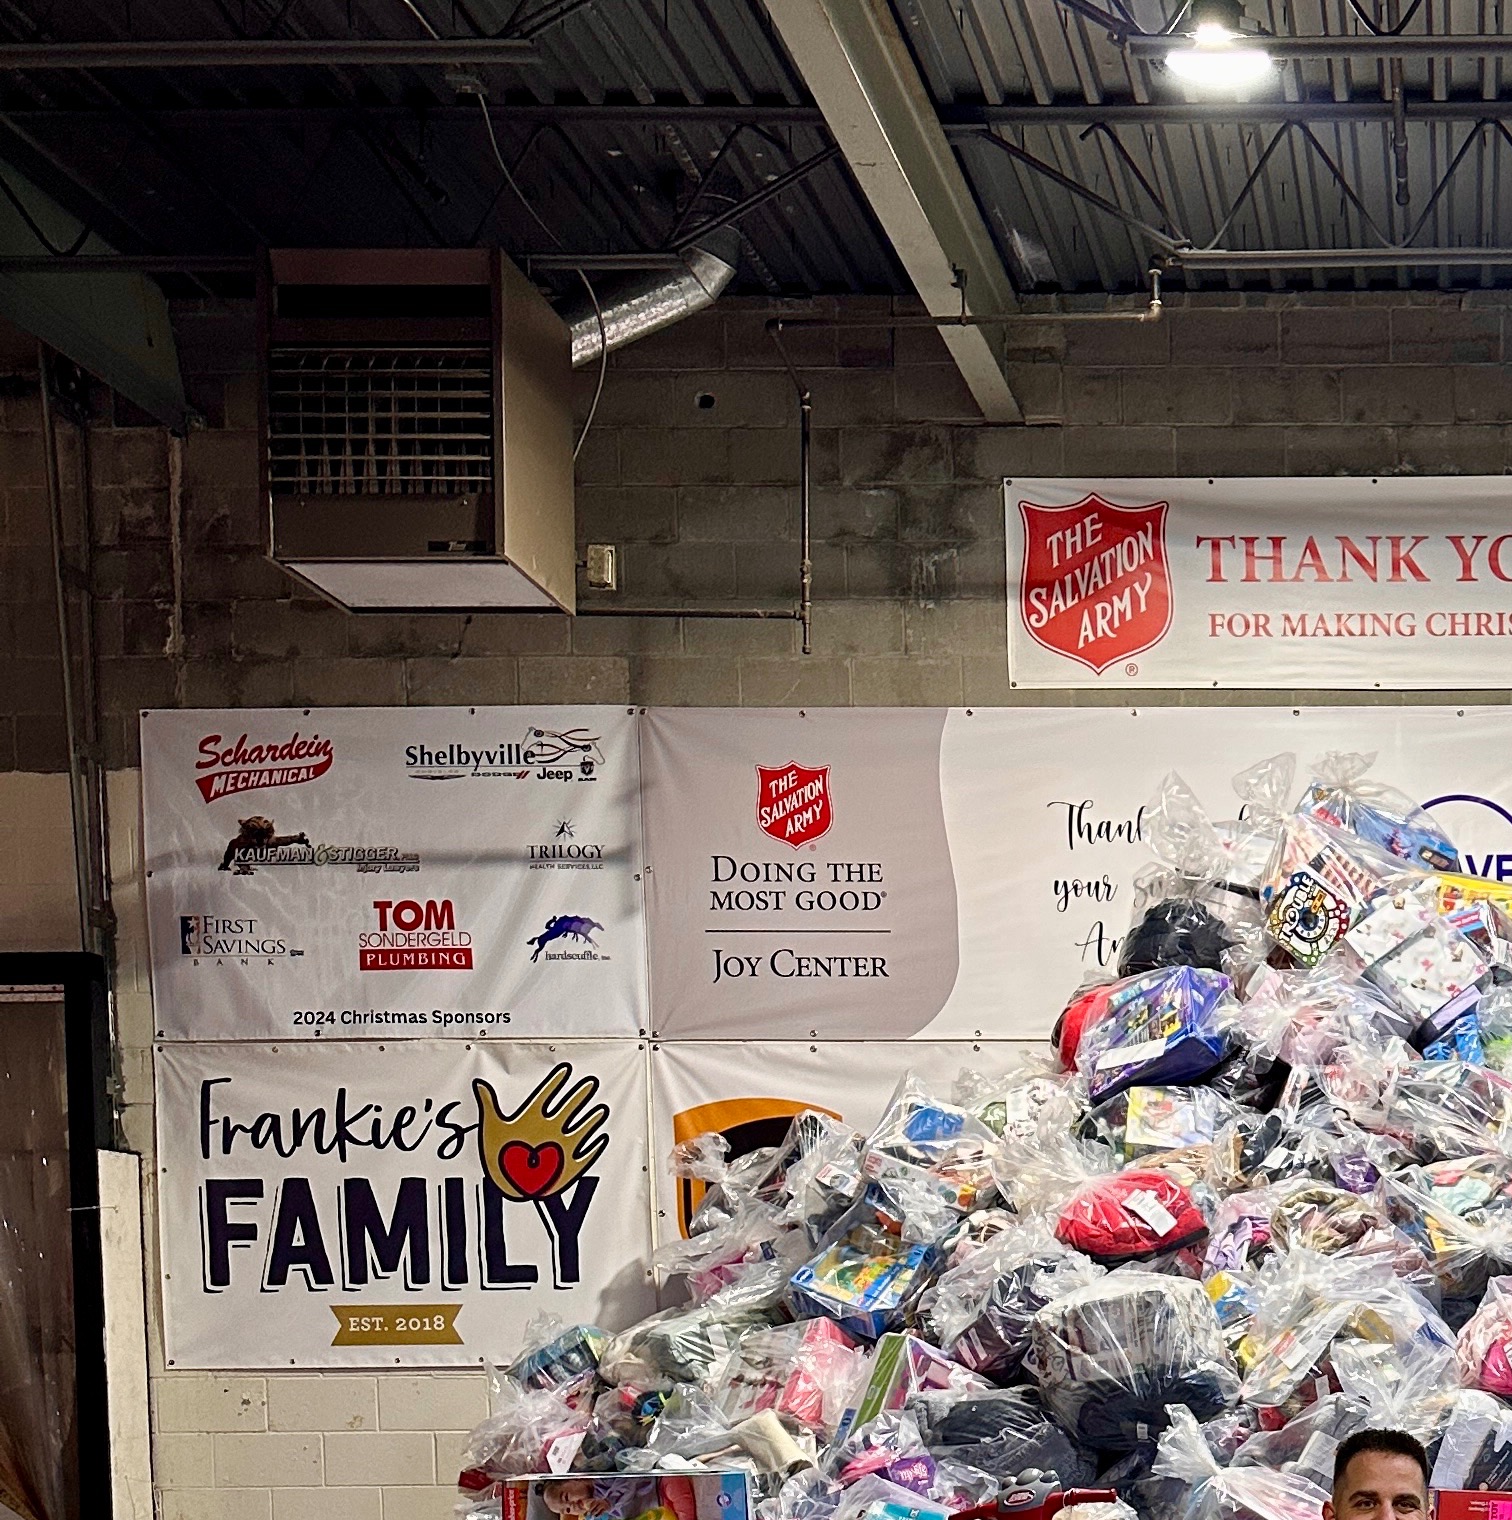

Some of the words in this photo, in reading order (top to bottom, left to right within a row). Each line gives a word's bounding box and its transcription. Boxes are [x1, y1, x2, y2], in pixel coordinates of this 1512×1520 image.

[1046, 514, 1103, 568] THE
[1196, 535, 1430, 584] THANK
[1029, 522, 1155, 627] SALVATION
[1077, 573, 1152, 650] ARMY
[1208, 612, 1274, 639] FOR
[1280, 612, 1418, 638] MAKING
[196, 732, 333, 770] Schardein
[406, 744, 536, 771] Shelbyville
[211, 767, 315, 798] MECHANICAL
[537, 768, 573, 782] Jeep
[768, 770, 799, 797] THE
[760, 774, 824, 829] SALVATION
[785, 802, 824, 838] ARMY
[234, 847, 313, 862] KAUFMAN
[328, 847, 398, 862] STIGGER
[527, 845, 605, 859] TRILOGY
[709, 890, 786, 911] MOST
[795, 889, 882, 911] GOOD
[1053, 876, 1118, 912] your
[373, 900, 454, 931] TOM
[1279, 873, 1315, 945] TROUBLE
[203, 916, 258, 934] FIRST
[359, 931, 472, 948] SONDERGELD
[203, 936, 286, 954] SAVINGS
[366, 952, 466, 968] PLUMBING
[293, 1010, 335, 1026] 2024
[341, 1009, 427, 1025] Christmas
[432, 1009, 511, 1026] Sponsors
[201, 1077, 480, 1161] Frankie's
[198, 1177, 599, 1293] FAMILY
[349, 1315, 387, 1331] EST.
[395, 1315, 446, 1331] 2018
